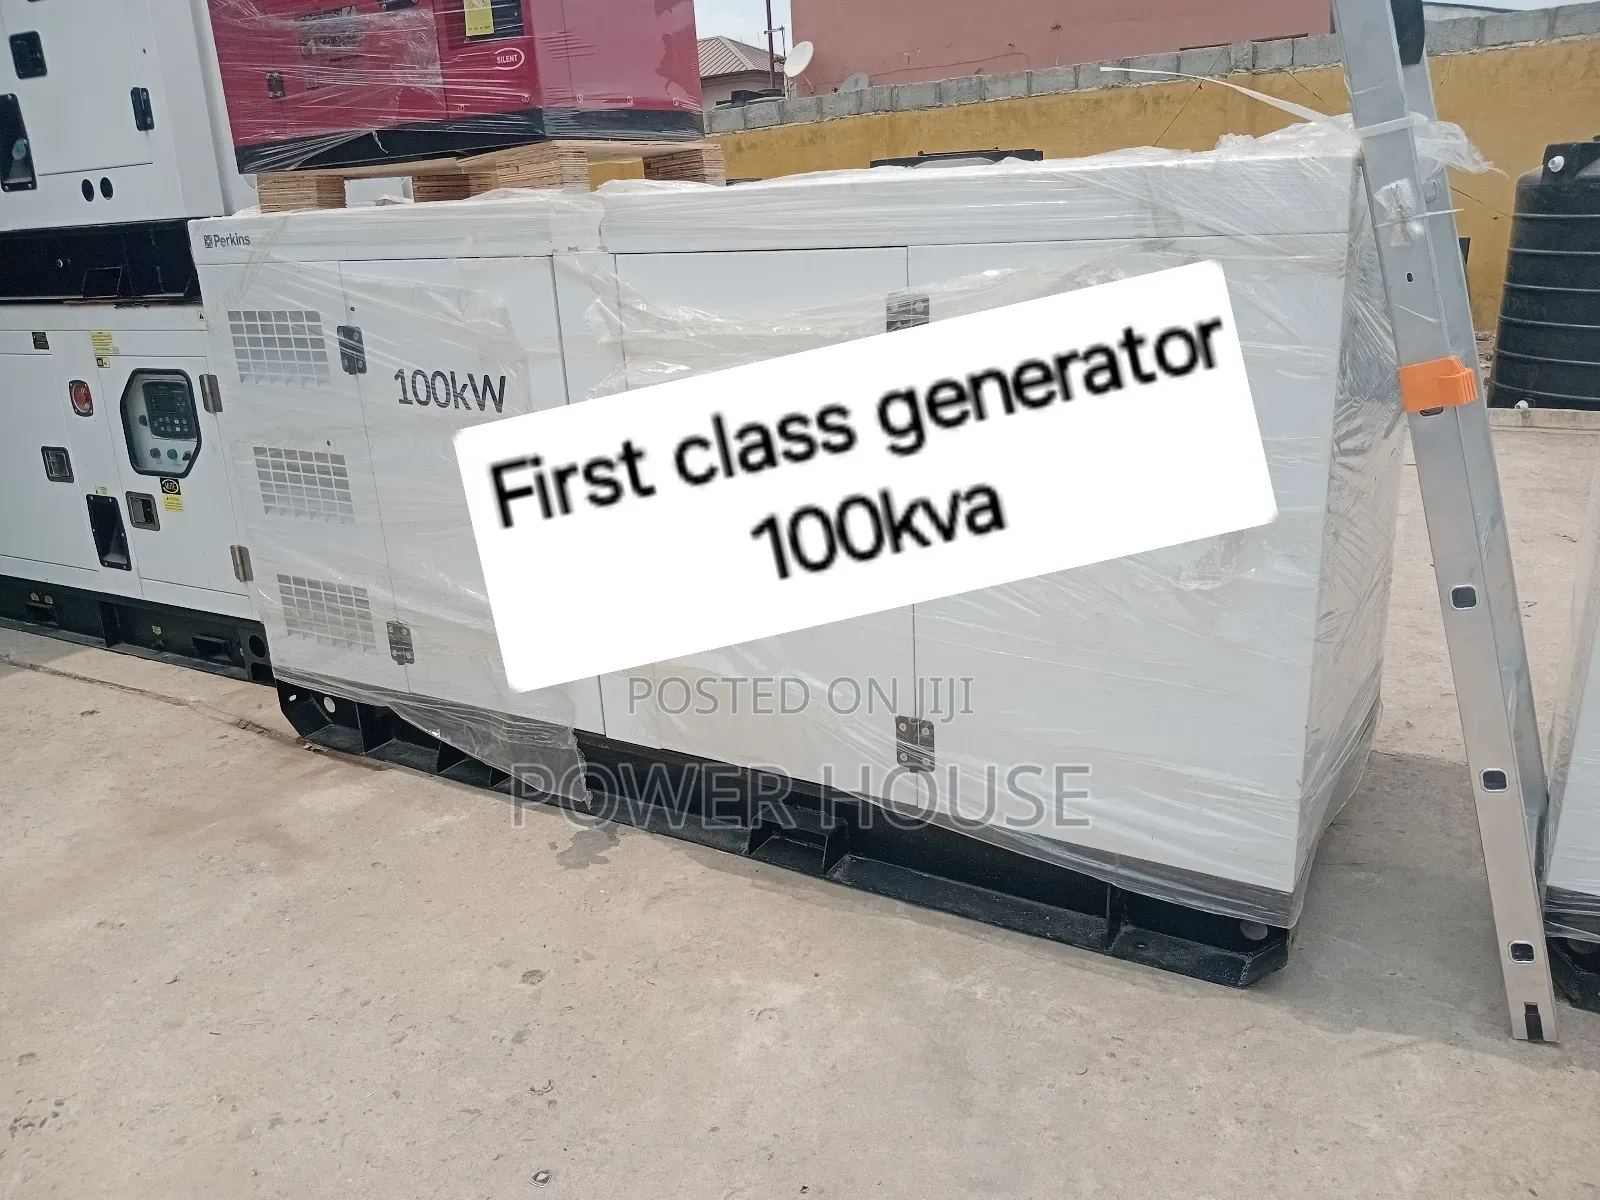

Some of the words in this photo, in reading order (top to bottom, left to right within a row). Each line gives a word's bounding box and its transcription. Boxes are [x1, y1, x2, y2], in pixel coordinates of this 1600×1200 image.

[496, 54, 518, 65] SILENT
[213, 233, 251, 248] Perkins
[394, 368, 506, 413] 100kW
